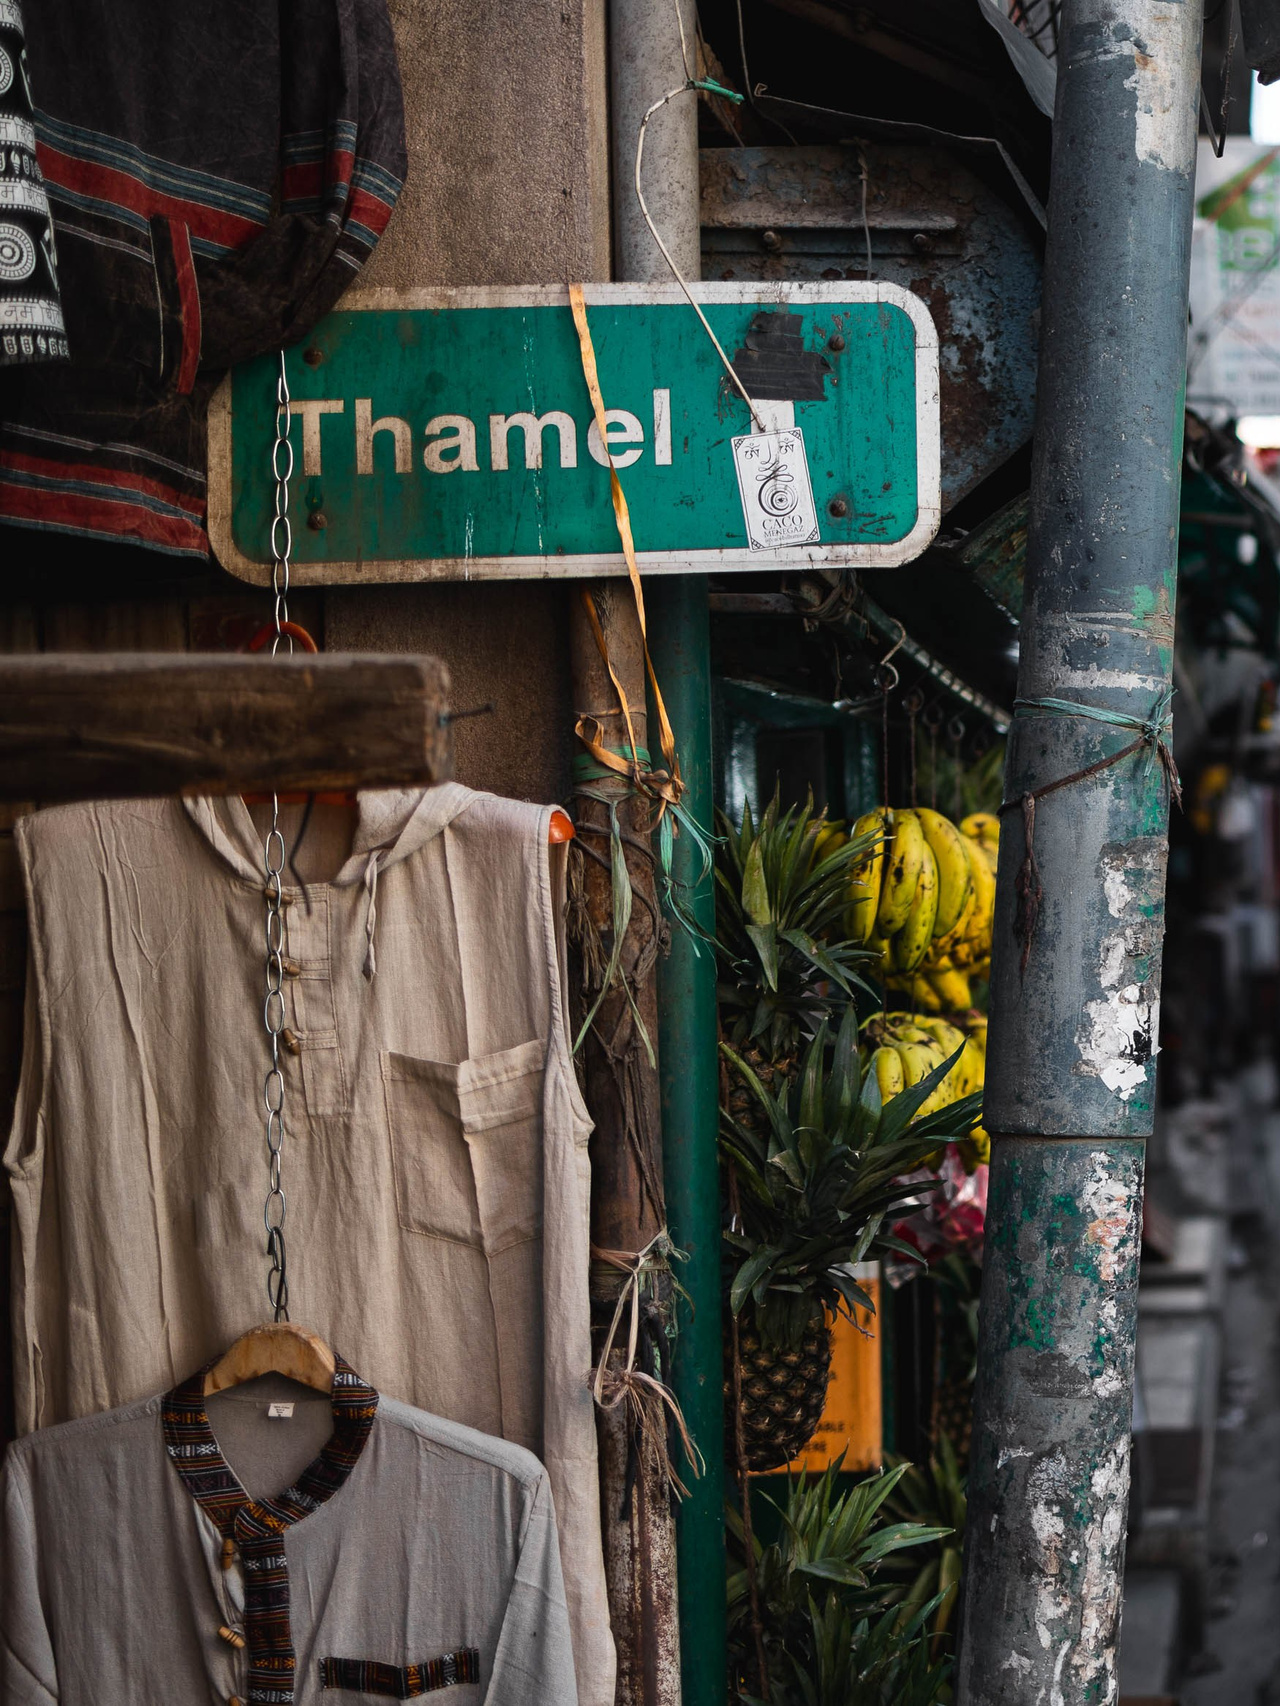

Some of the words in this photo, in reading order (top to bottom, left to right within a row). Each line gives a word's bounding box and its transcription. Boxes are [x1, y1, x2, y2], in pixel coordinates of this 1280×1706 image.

[280, 388, 673, 475] Thamel
[762, 514, 803, 531] CACO
[763, 525, 805, 538] MENEGAZ
